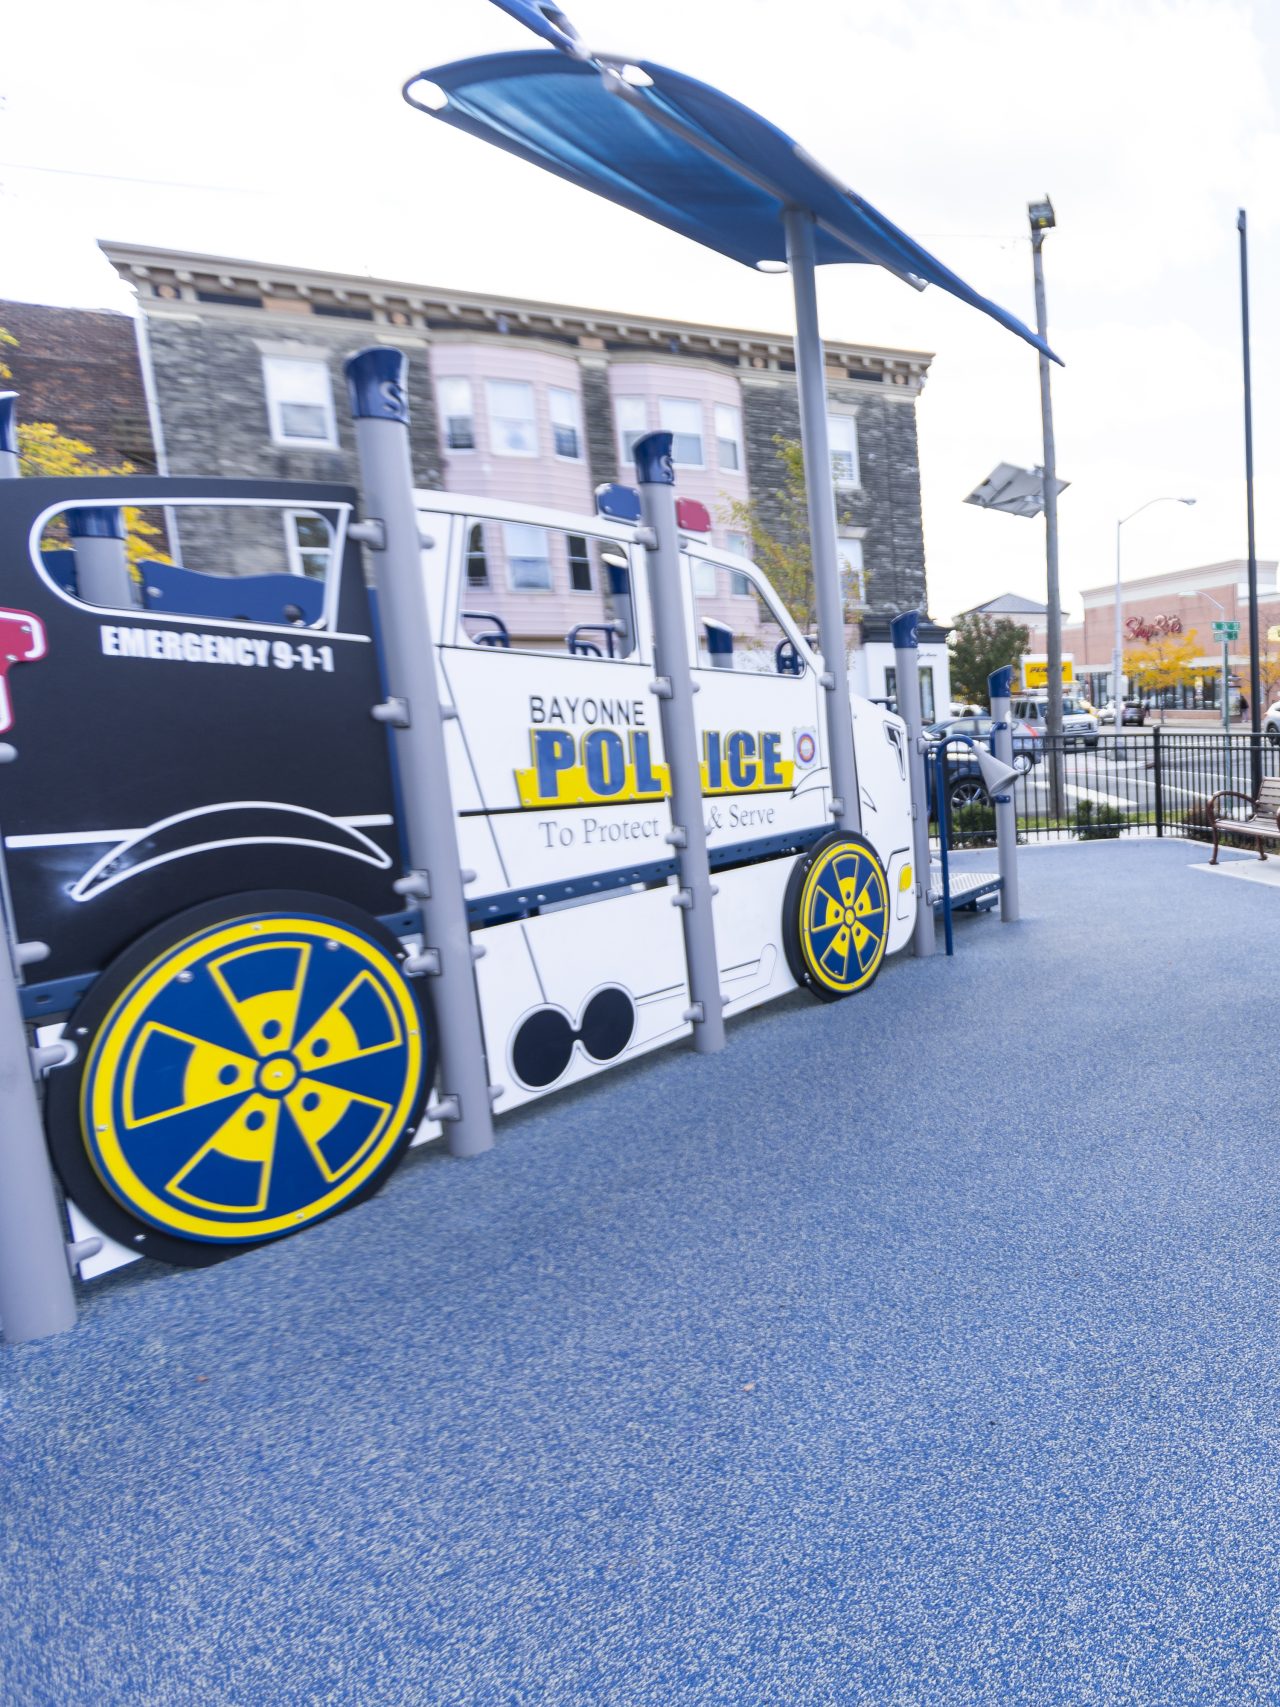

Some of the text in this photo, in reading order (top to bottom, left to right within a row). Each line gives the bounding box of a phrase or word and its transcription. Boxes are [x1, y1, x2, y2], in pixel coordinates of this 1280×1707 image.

[101, 625, 334, 673] EMERGENCY 9-1-1
[530, 695, 644, 726] BAYONNE
[529, 728, 784, 799] POLICE
[539, 803, 775, 848] To Protect & Serve
